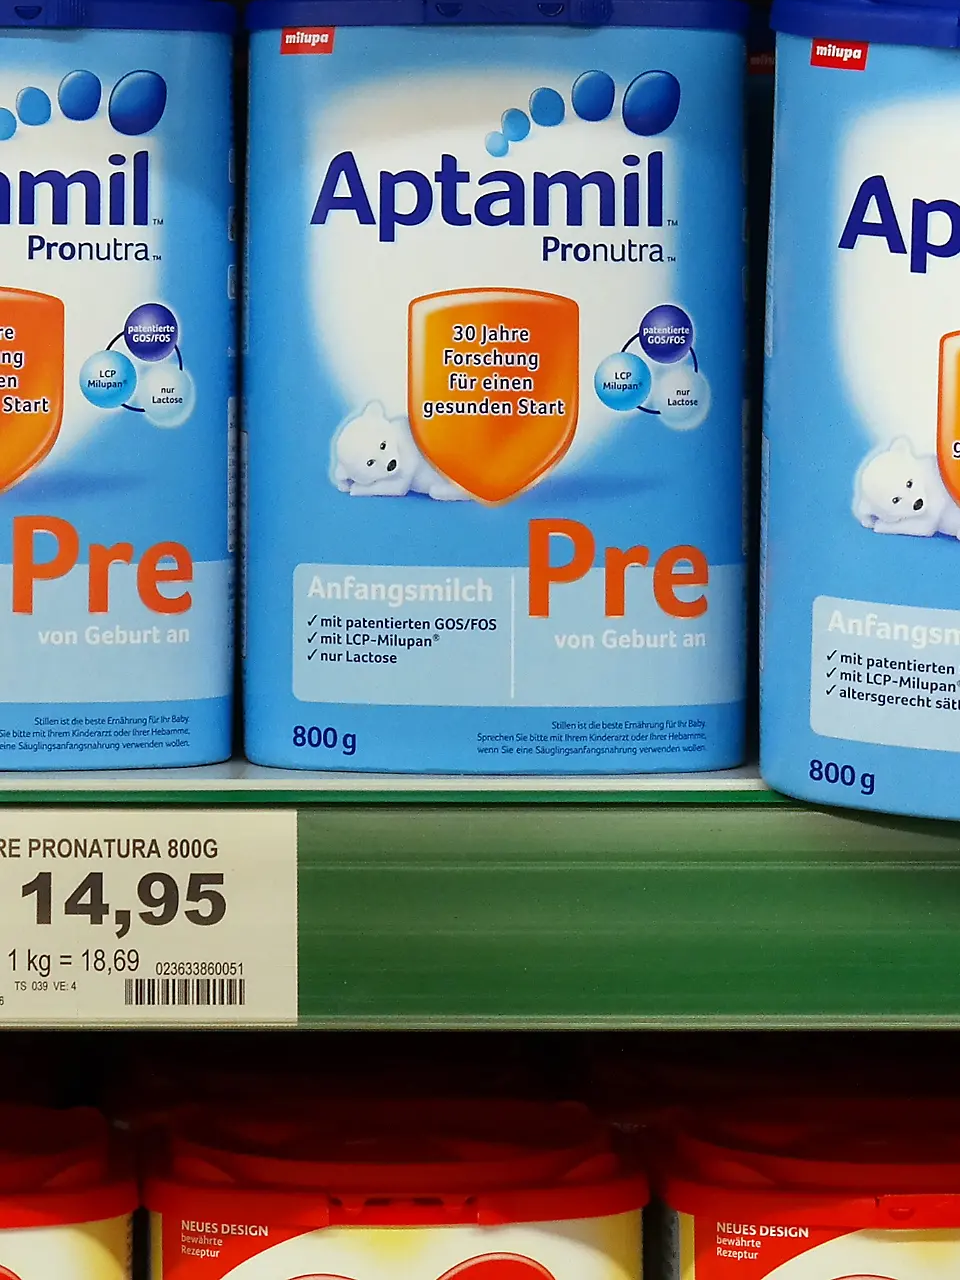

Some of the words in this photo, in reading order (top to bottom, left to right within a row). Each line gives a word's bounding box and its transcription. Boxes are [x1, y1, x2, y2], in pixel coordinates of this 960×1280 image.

[285, 31, 329, 46] milupa
[816, 44, 862, 62] milupa
[528, 518, 709, 618] Pre
[307, 576, 493, 607] Anfangsmilch
[840, 653, 862, 665] mit
[866, 655, 954, 675] patentierten
[839, 687, 931, 708] altersgerecht
[808, 760, 856, 787] 800
[860, 767, 876, 794] g
[28, 838, 161, 858] PRONATURA
[167, 838, 219, 859] 800G
[22, 872, 227, 939] 14,95
[8, 949, 17, 971] 1
[28, 949, 51, 977] kg
[82, 949, 139, 975] 18,69
[155, 962, 244, 975] 023633860051
[716, 1221, 756, 1235] NEUES
[759, 1225, 809, 1238] DESIGN
[716, 1235, 761, 1249] bewährte
[716, 1247, 759, 1260] Rezeptur
